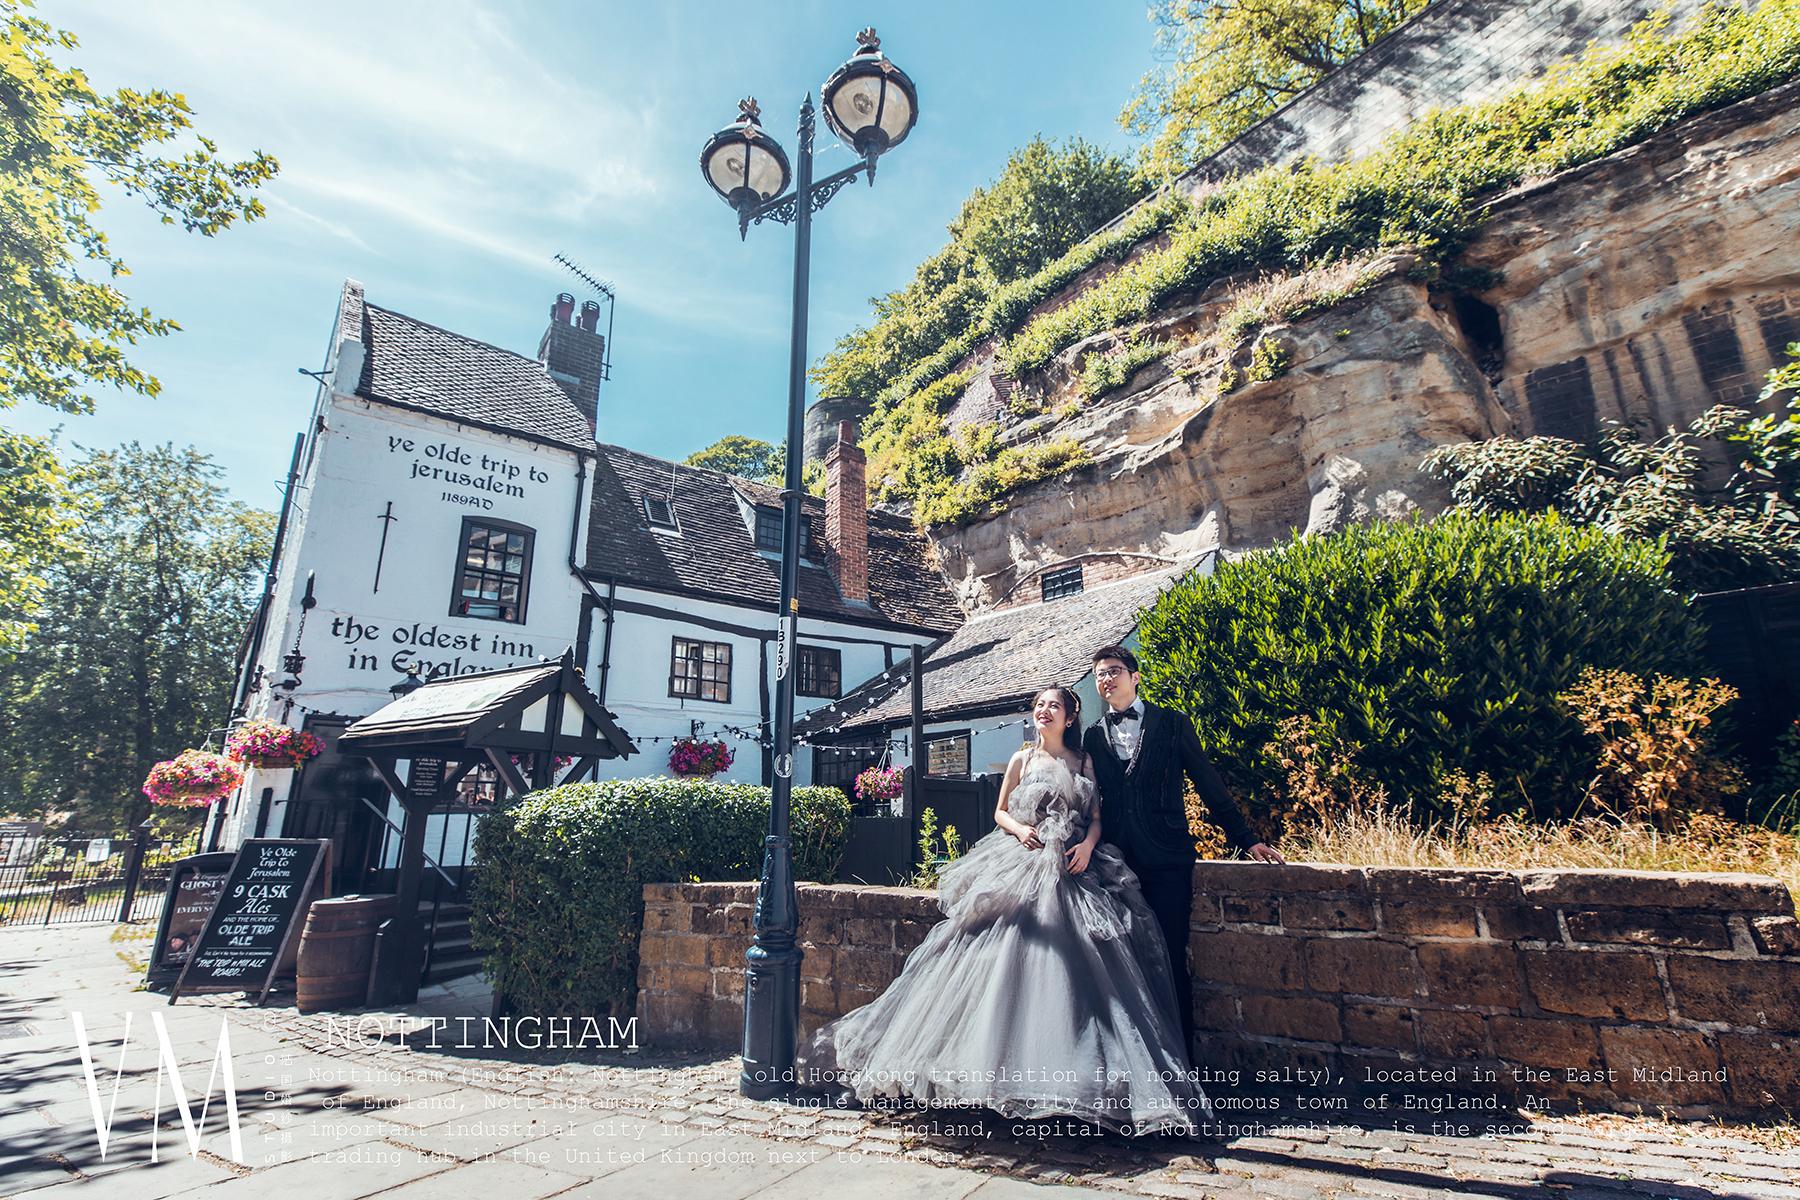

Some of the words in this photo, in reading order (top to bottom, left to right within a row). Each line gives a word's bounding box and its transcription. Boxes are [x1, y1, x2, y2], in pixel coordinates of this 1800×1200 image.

[388, 435, 415, 453] ye
[424, 443, 472, 466] olde
[481, 454, 521, 480] trip
[529, 465, 549, 484] to
[409, 459, 525, 499] jerusalem
[441, 492, 494, 511] 1189AD
[331, 615, 380, 645] the
[392, 623, 481, 652] oldest
[491, 634, 534, 658] inn
[777, 619, 785, 678] 13290
[348, 647, 378, 671] in
[247, 867, 291, 880] Jerusalem
[233, 886, 245, 898] 9
[247, 885, 292, 899] CASK
[236, 899, 271, 913] Ales
[218, 925, 251, 936] OLDE
[250, 925, 275, 935] TRIP
[228, 936, 255, 947] ALE
